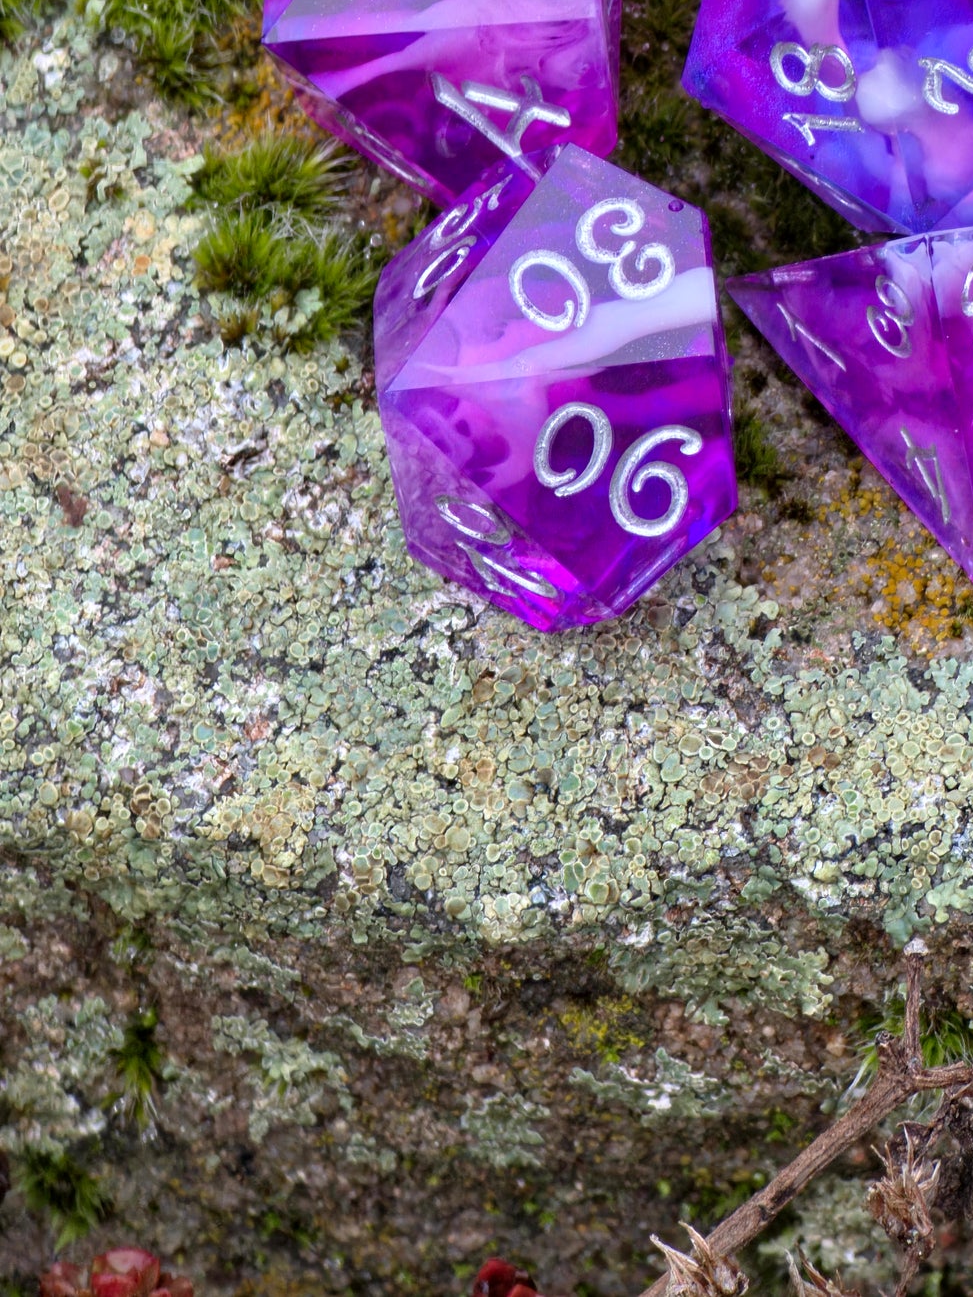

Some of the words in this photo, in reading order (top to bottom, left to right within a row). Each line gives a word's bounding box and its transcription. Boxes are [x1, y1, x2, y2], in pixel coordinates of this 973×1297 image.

[431, 72, 570, 178] 4
[770, 42, 863, 146] 18
[509, 198, 676, 332] 30
[777, 303, 847, 373] 1
[867, 275, 914, 359] 3
[900, 427, 951, 525] 4
